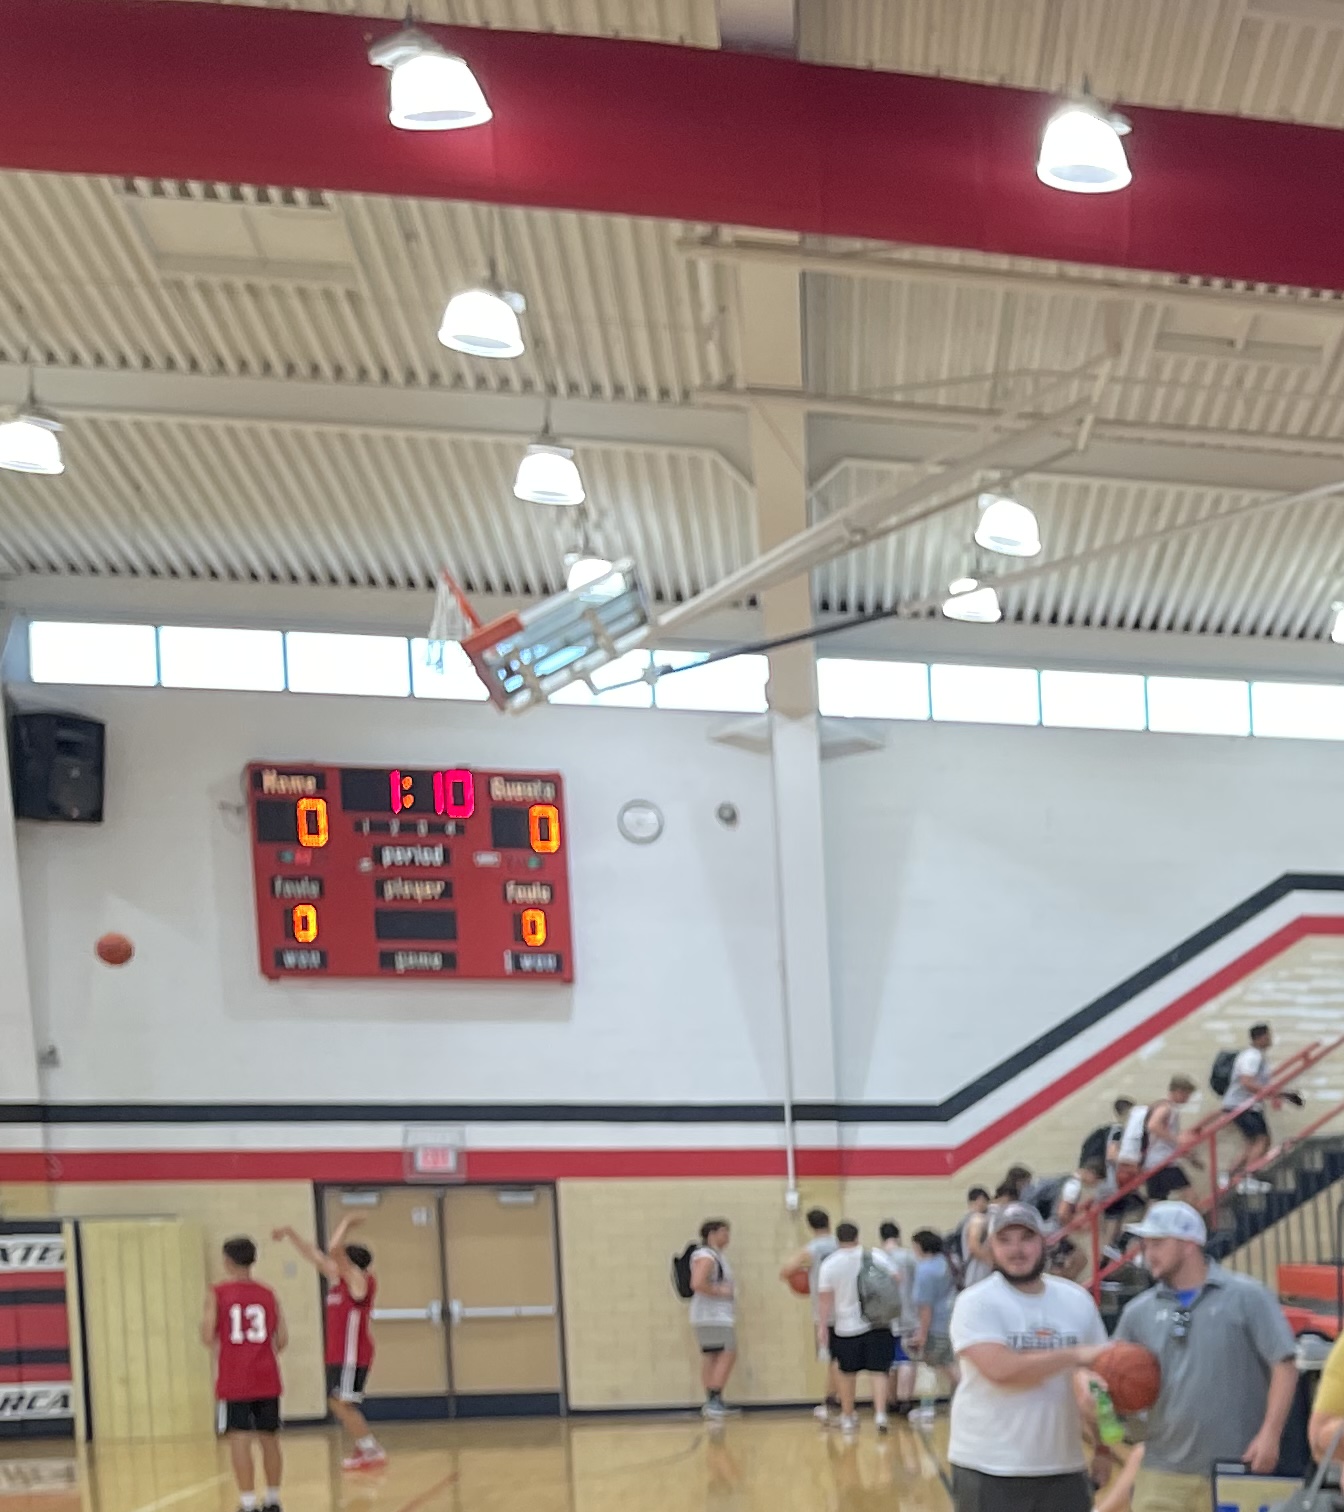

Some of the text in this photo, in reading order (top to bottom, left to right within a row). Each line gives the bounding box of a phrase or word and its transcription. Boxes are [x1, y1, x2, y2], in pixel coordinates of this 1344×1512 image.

[389, 768, 475, 819] 1:10
[297, 798, 328, 847] 0
[528, 804, 560, 853] 0
[293, 904, 318, 942] 0
[522, 908, 547, 947] 0
[228, 1303, 268, 1345] 13
